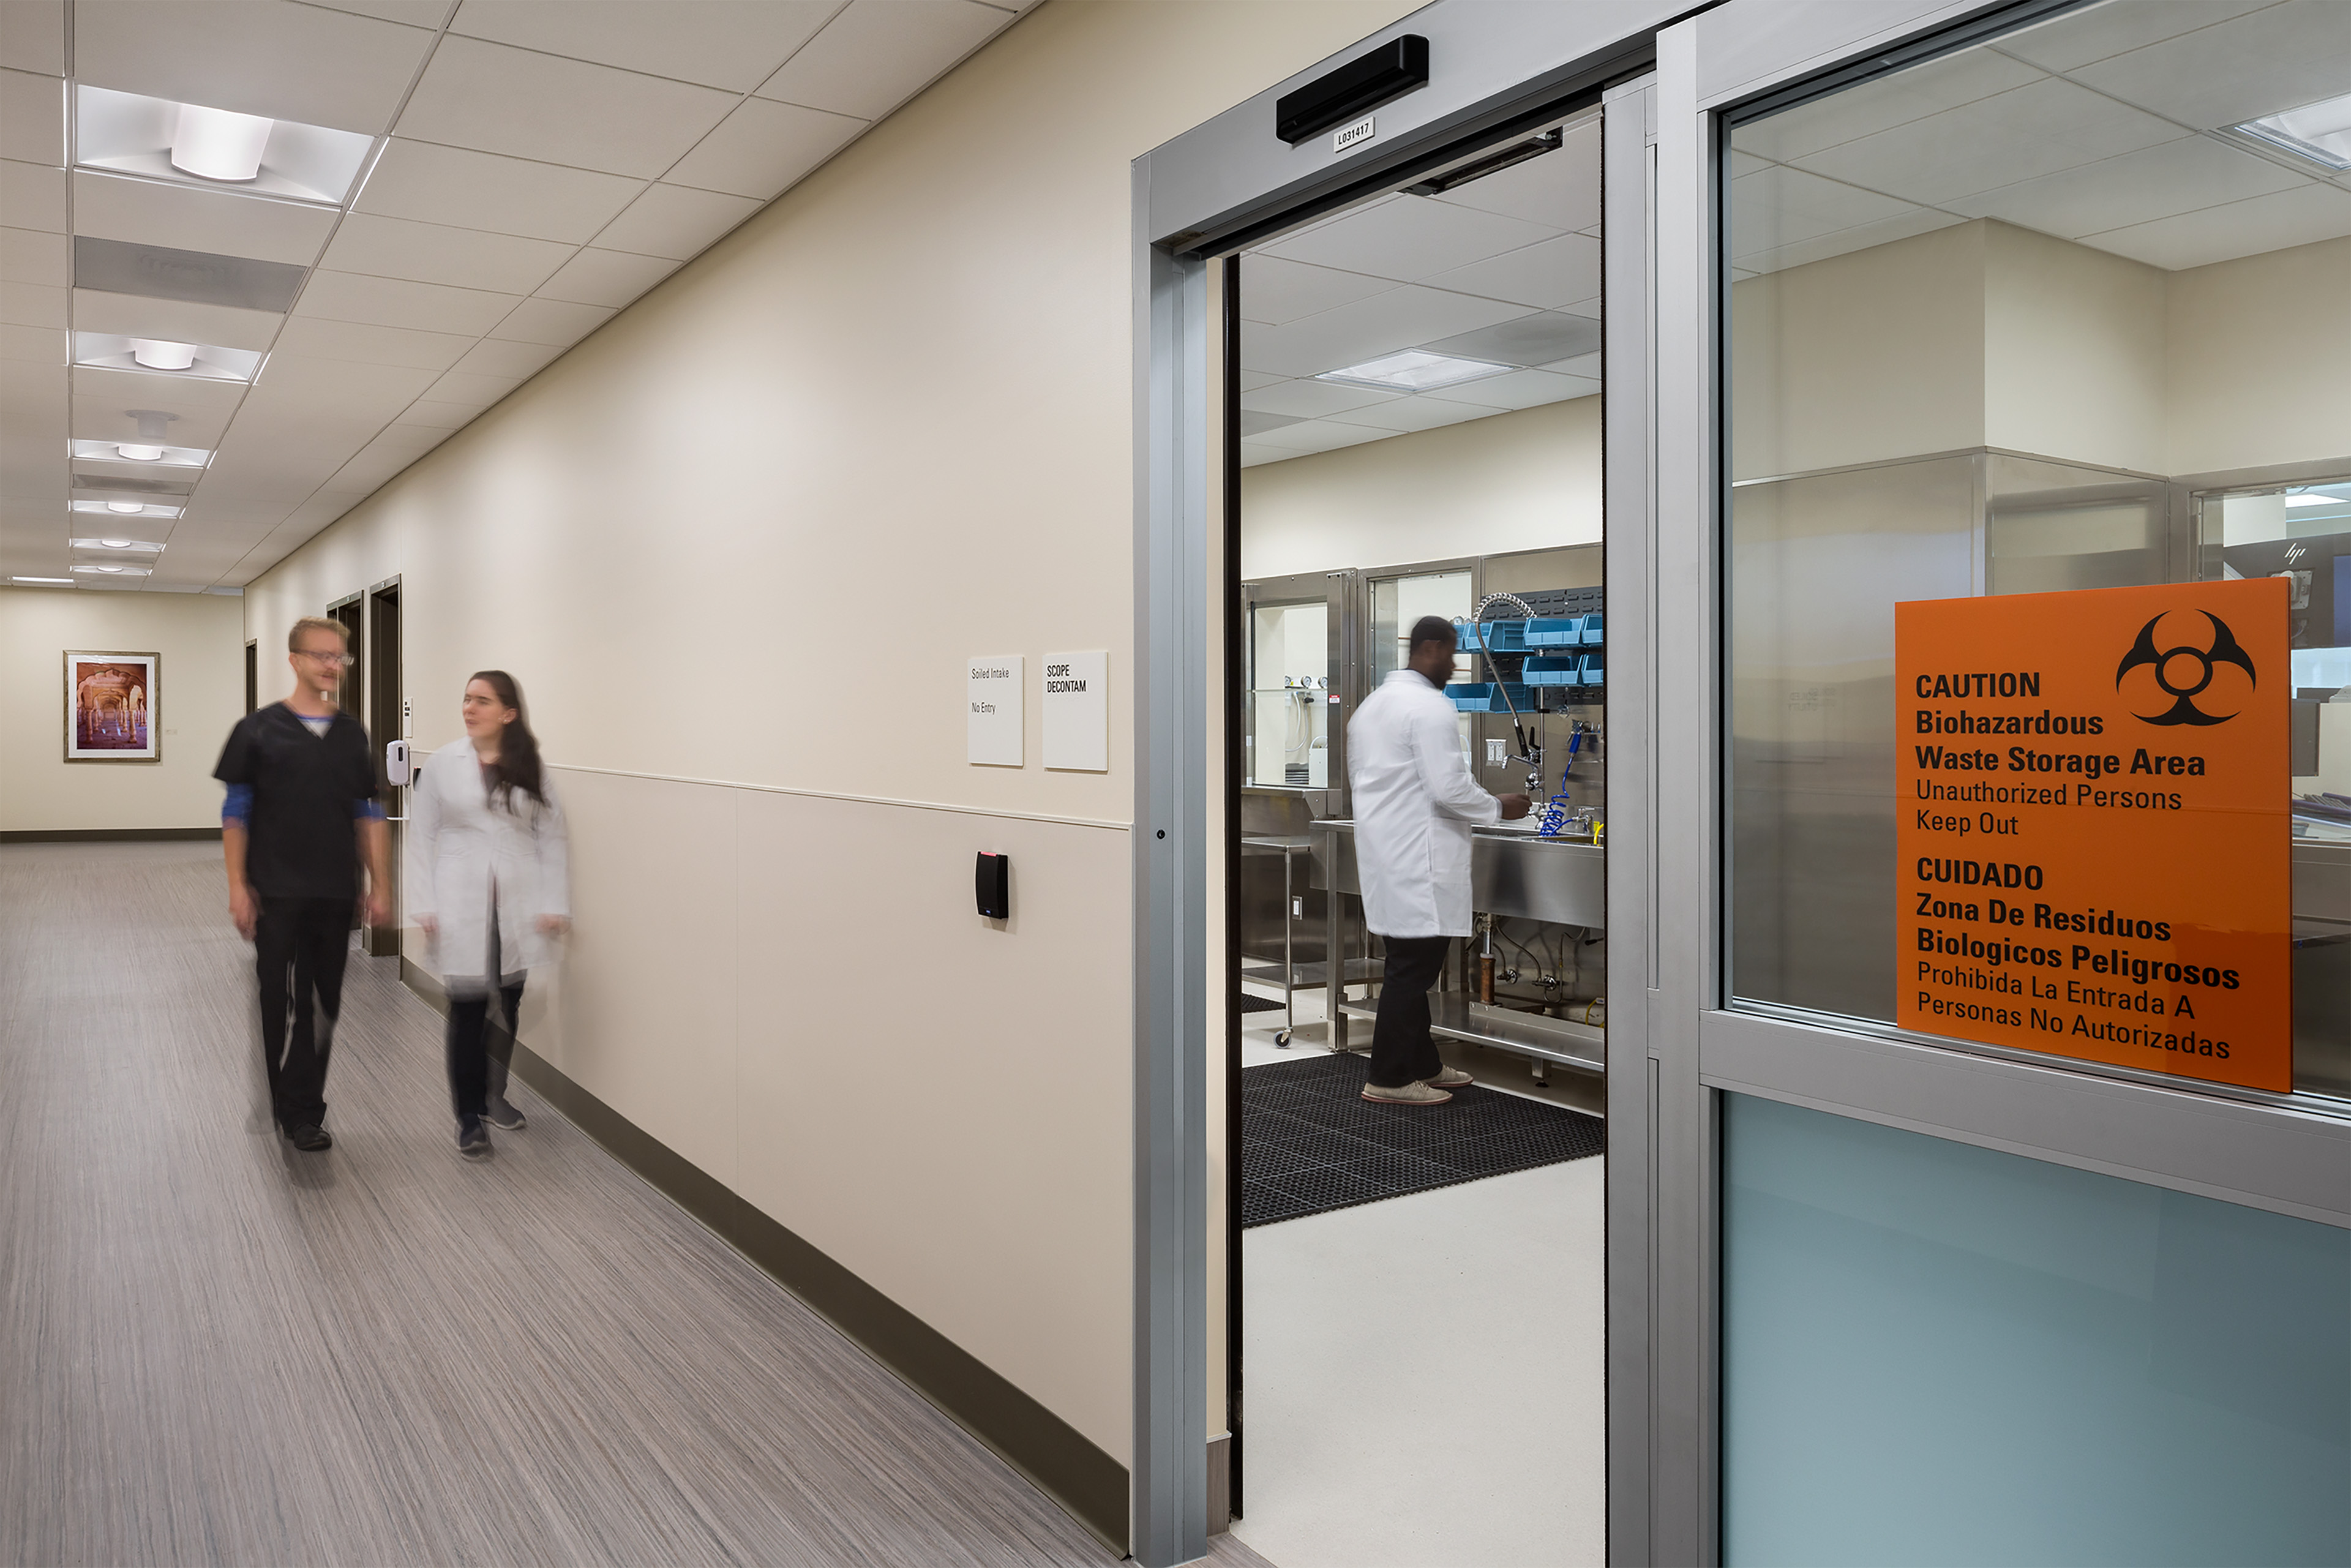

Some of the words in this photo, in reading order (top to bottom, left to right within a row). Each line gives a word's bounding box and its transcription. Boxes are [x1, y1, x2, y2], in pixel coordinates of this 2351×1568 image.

[1338, 123, 1369, 145] L031417
[972, 669, 989, 679] Soiled
[991, 667, 1009, 678] Intake
[1047, 665, 1070, 677] SCOPE
[1047, 680, 1086, 693] DECONTAM
[1916, 672, 2040, 699] CAUTION
[972, 702, 980, 713] No
[981, 702, 996, 715] Entry
[1916, 709, 2104, 735] Biohazardous
[1914, 745, 1999, 771] Waste
[2008, 746, 2120, 780] Storage
[2129, 748, 2205, 776] Area
[1917, 779, 2067, 806] Unauthorized
[2077, 784, 2182, 810] Persons
[1917, 809, 1971, 837] Keep
[1979, 812, 2019, 835] Out
[1917, 857, 2043, 891] CUIDADO
[1916, 892, 1979, 921] Zona
[1989, 899, 2025, 926] De
[2034, 903, 2171, 942] Residuos
[1918, 927, 2062, 971] Biologicos
[2072, 944, 2240, 990] Peligrosos
[1918, 961, 2022, 995] Prohibida
[2032, 975, 2057, 1000] La
[2068, 980, 2165, 1015] Entrada
[2174, 994, 2195, 1019] A
[1918, 991, 2022, 1027] Personas
[2030, 1007, 2063, 1033] No
[2071, 1014, 2230, 1059] Autorizadas
